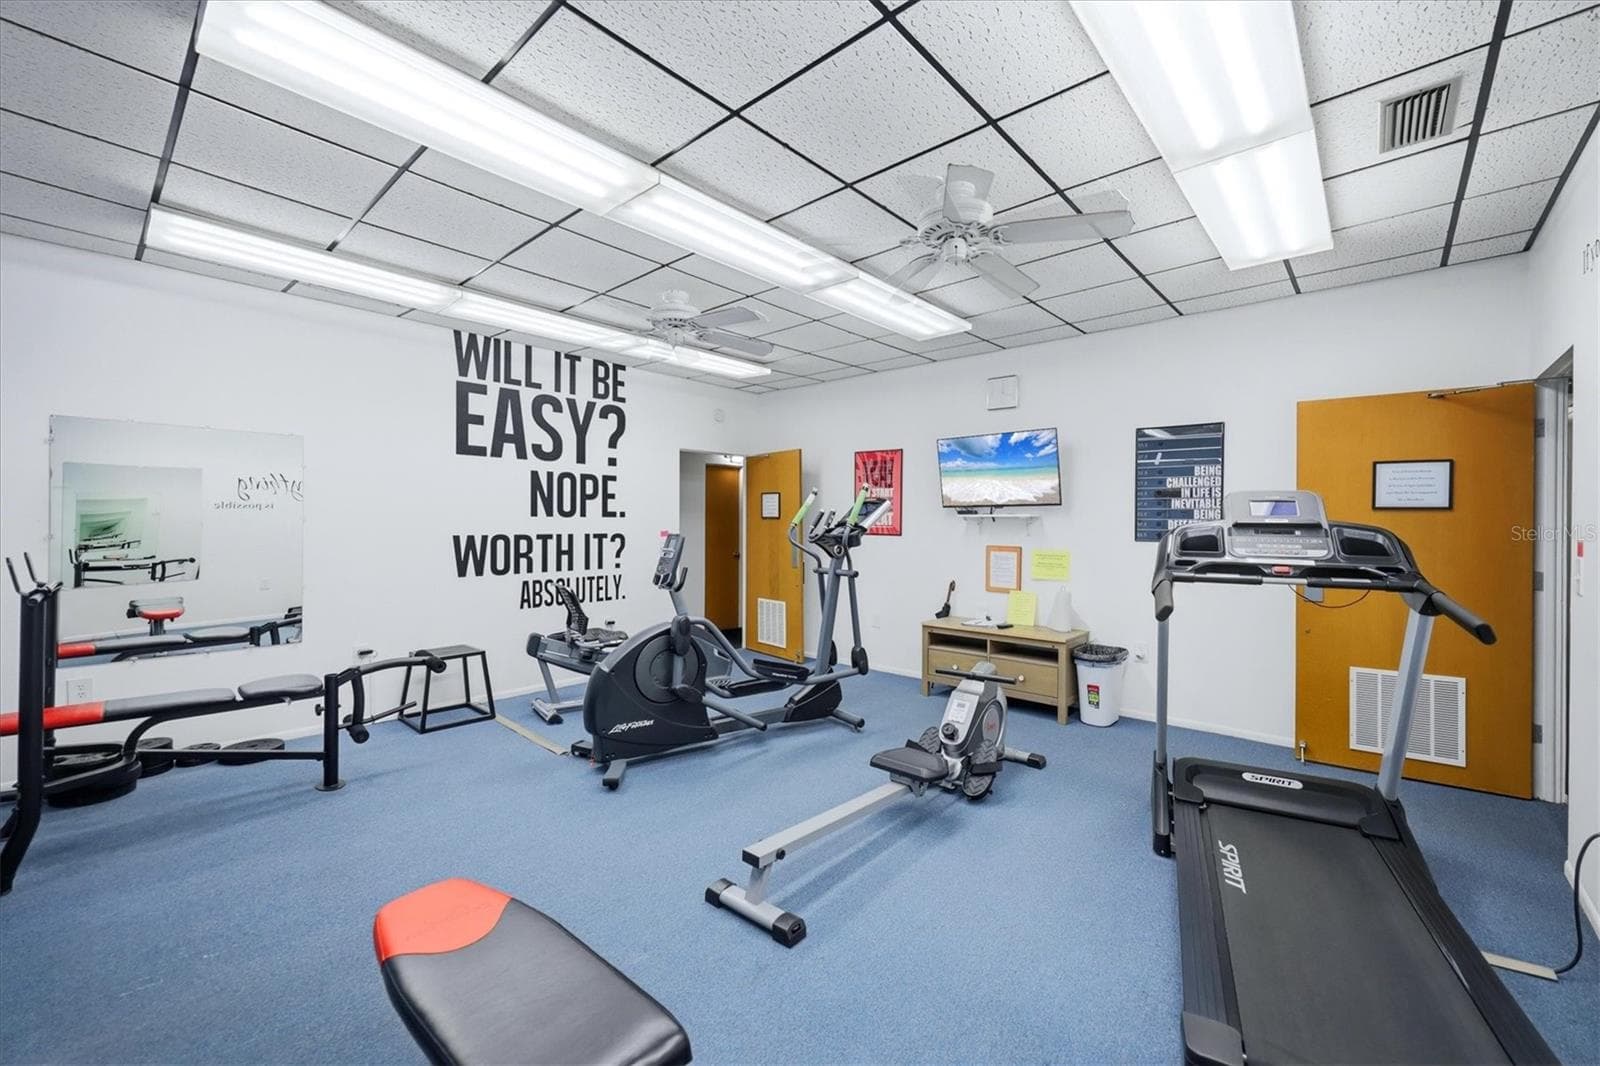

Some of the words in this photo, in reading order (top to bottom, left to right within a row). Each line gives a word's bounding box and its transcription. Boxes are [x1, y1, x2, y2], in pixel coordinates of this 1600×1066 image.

[453, 330, 542, 390] WILL
[554, 351, 582, 395] IT
[592, 358, 626, 403] BE
[456, 380, 626, 467] EASY?
[1194, 464, 1222, 476] BEING
[1166, 476, 1222, 488] CHALLENGED
[530, 470, 626, 518] NOPE.
[1181, 487, 1190, 498] IN
[1192, 487, 1211, 498] LIFE
[1212, 486, 1222, 497] IS
[1171, 497, 1222, 510] INEVITABLE
[1193, 509, 1221, 520] BEING
[452, 533, 574, 578] WORTH
[584, 532, 626, 571] IT?
[1250, 774, 1294, 786] SPIRIT
[1217, 840, 1247, 895] SPIRIT
